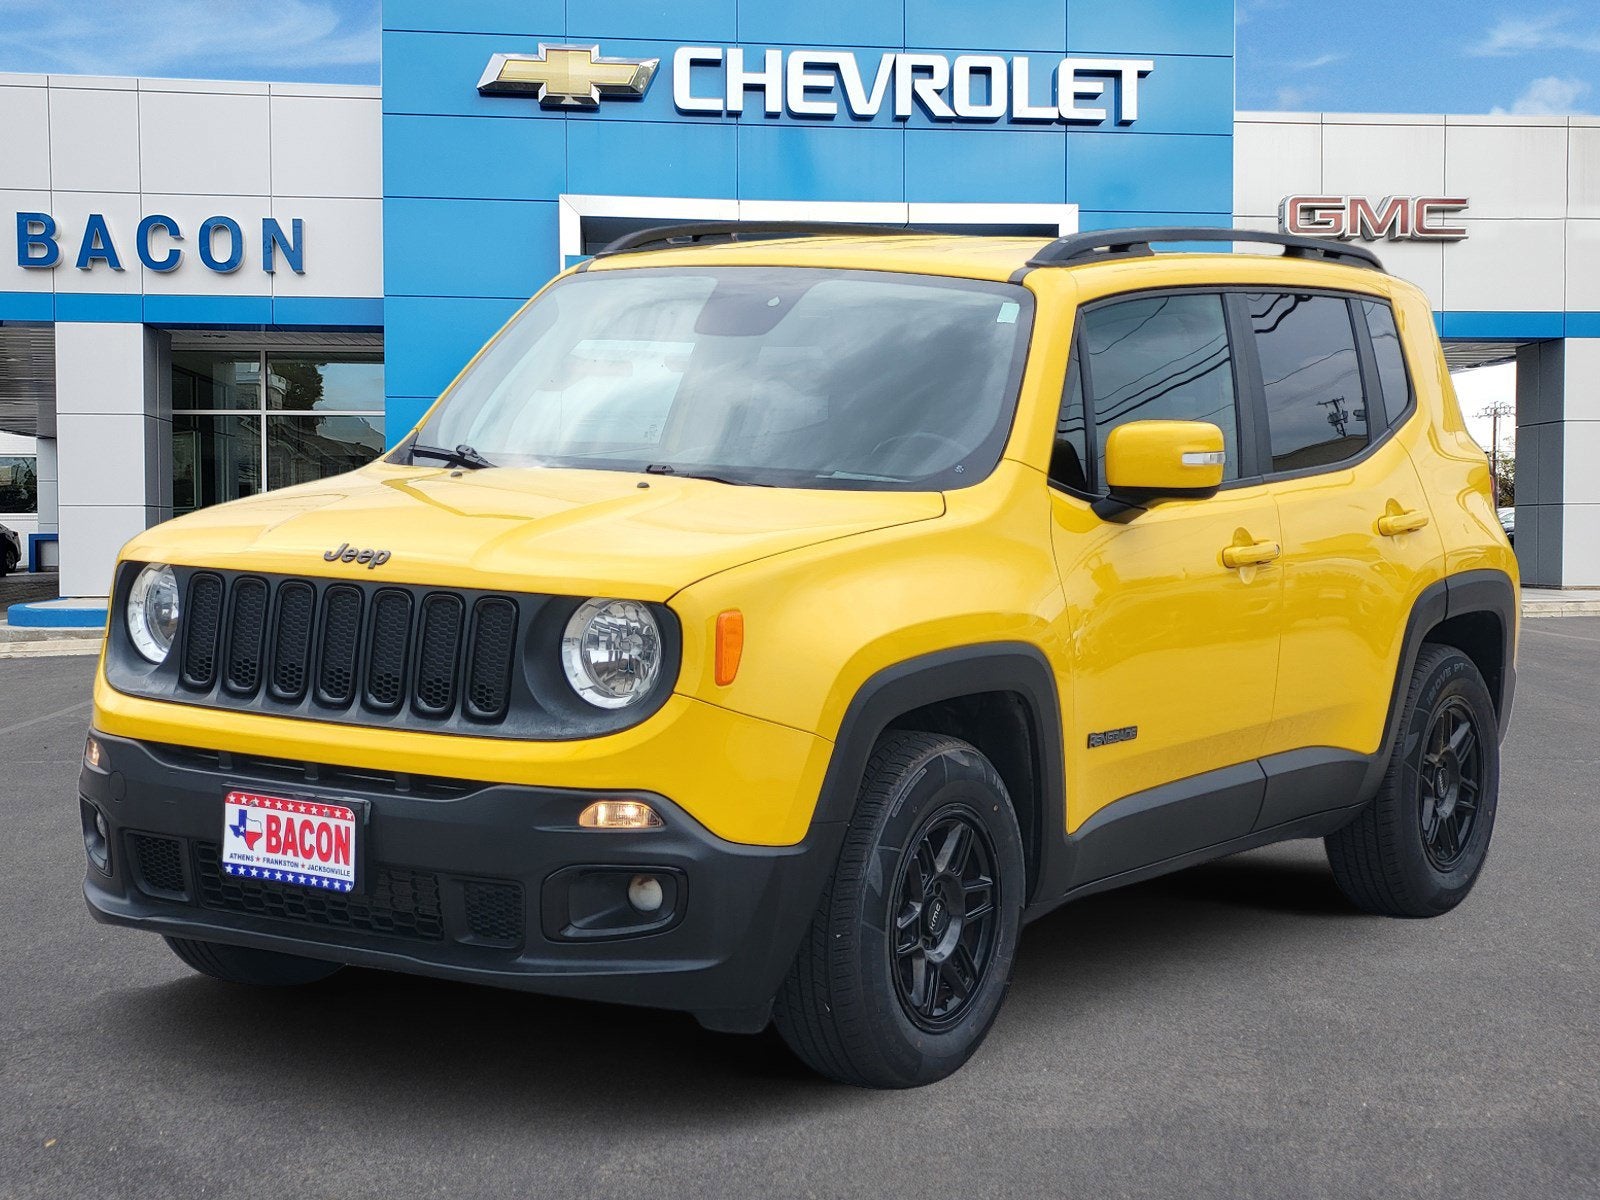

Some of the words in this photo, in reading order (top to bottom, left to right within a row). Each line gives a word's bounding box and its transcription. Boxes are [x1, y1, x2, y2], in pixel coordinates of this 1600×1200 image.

[673, 46, 1154, 126] CHEVROLET
[16, 211, 306, 275] BACON
[1280, 194, 1470, 243] GMC
[323, 543, 391, 570] Jeep
[1087, 725, 1138, 749] RENEGADE
[229, 852, 255, 863] ATHENS
[262, 856, 299, 869] FRANKSTON
[307, 864, 351, 877] JACKSONVILLE
[266, 814, 351, 866] BACON
